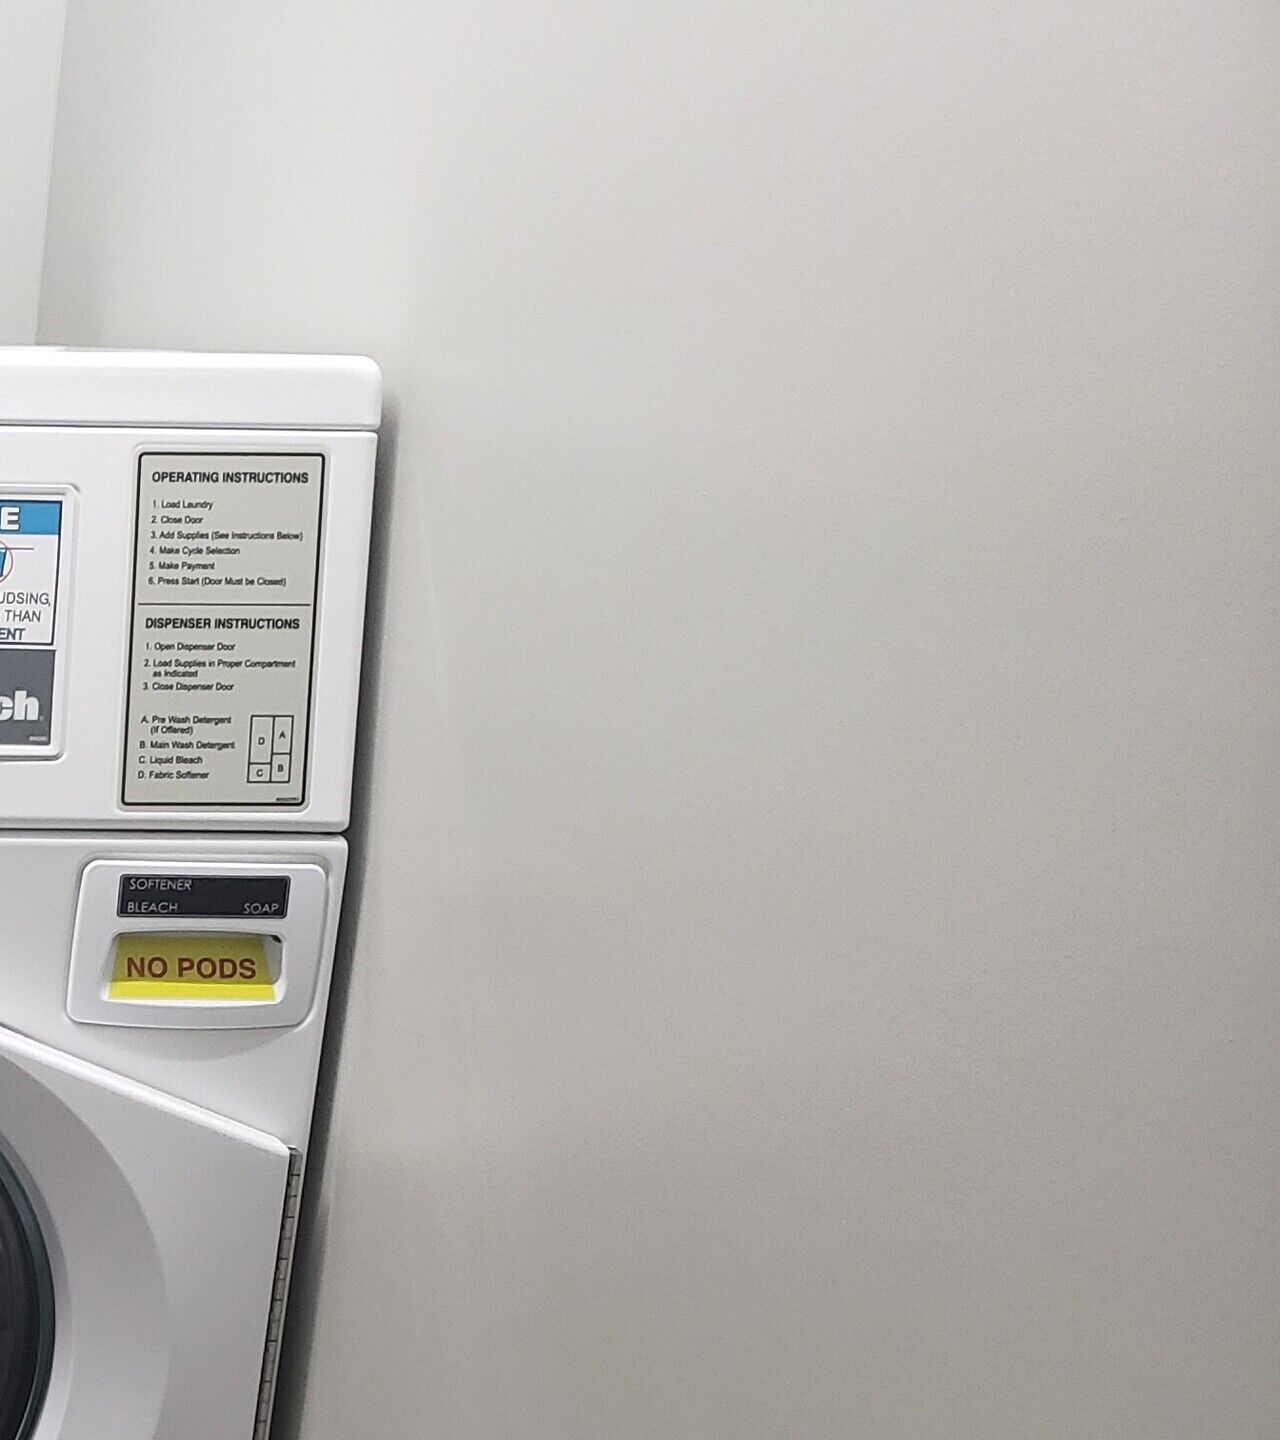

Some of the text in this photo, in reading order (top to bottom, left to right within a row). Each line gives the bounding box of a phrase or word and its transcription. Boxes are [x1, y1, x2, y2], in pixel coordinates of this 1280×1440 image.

[152, 472, 309, 484] OPERATING INSTRUCTIONS
[162, 501, 180, 509] Load
[183, 501, 213, 510] Laundry
[161, 516, 182, 524] Close
[185, 516, 203, 524] Door
[159, 531, 174, 539] Add
[177, 531, 209, 541] Supplies
[211, 532, 228, 541] (See
[277, 532, 303, 541] Below)
[160, 546, 180, 554] Make
[182, 547, 203, 557] Cycle
[206, 547, 240, 555] Selection
[182, 562, 215, 571] Payment
[158, 577, 179, 585] Press
[182, 577, 199, 585] Start
[202, 577, 222, 587] (Door
[225, 577, 243, 585] Must
[4, 609, 41, 622] THAN
[145, 618, 300, 629] DISPENSER INSTRUCTIONS
[154, 643, 175, 652] Open
[177, 642, 214, 652] Dispenser
[217, 643, 235, 651] Door
[153, 659, 172, 667] Load
[175, 659, 206, 669] Supplies
[217, 660, 242, 669] Proper
[245, 660, 296, 669] Compartment
[152, 682, 173, 691] Close
[176, 682, 213, 692] Dispenser
[216, 683, 234, 691] Door
[152, 716, 166, 724] Pre
[168, 716, 190, 724] Wash
[193, 716, 231, 726] Detergent
[279, 731, 286, 739] A
[150, 741, 169, 749] Main
[172, 741, 194, 749] Wash
[196, 741, 235, 751] Detergent
[258, 737, 264, 745] D
[150, 756, 174, 766] Liquid
[176, 756, 203, 764] Bleach
[256, 769, 263, 777] C
[278, 764, 283, 772] B
[149, 771, 173, 779] Fabric
[176, 771, 209, 779] Softener
[129, 879, 192, 891] SOFTENER
[127, 902, 279, 915] BLEACH SOAP
[127, 957, 256, 980] NO PODS
